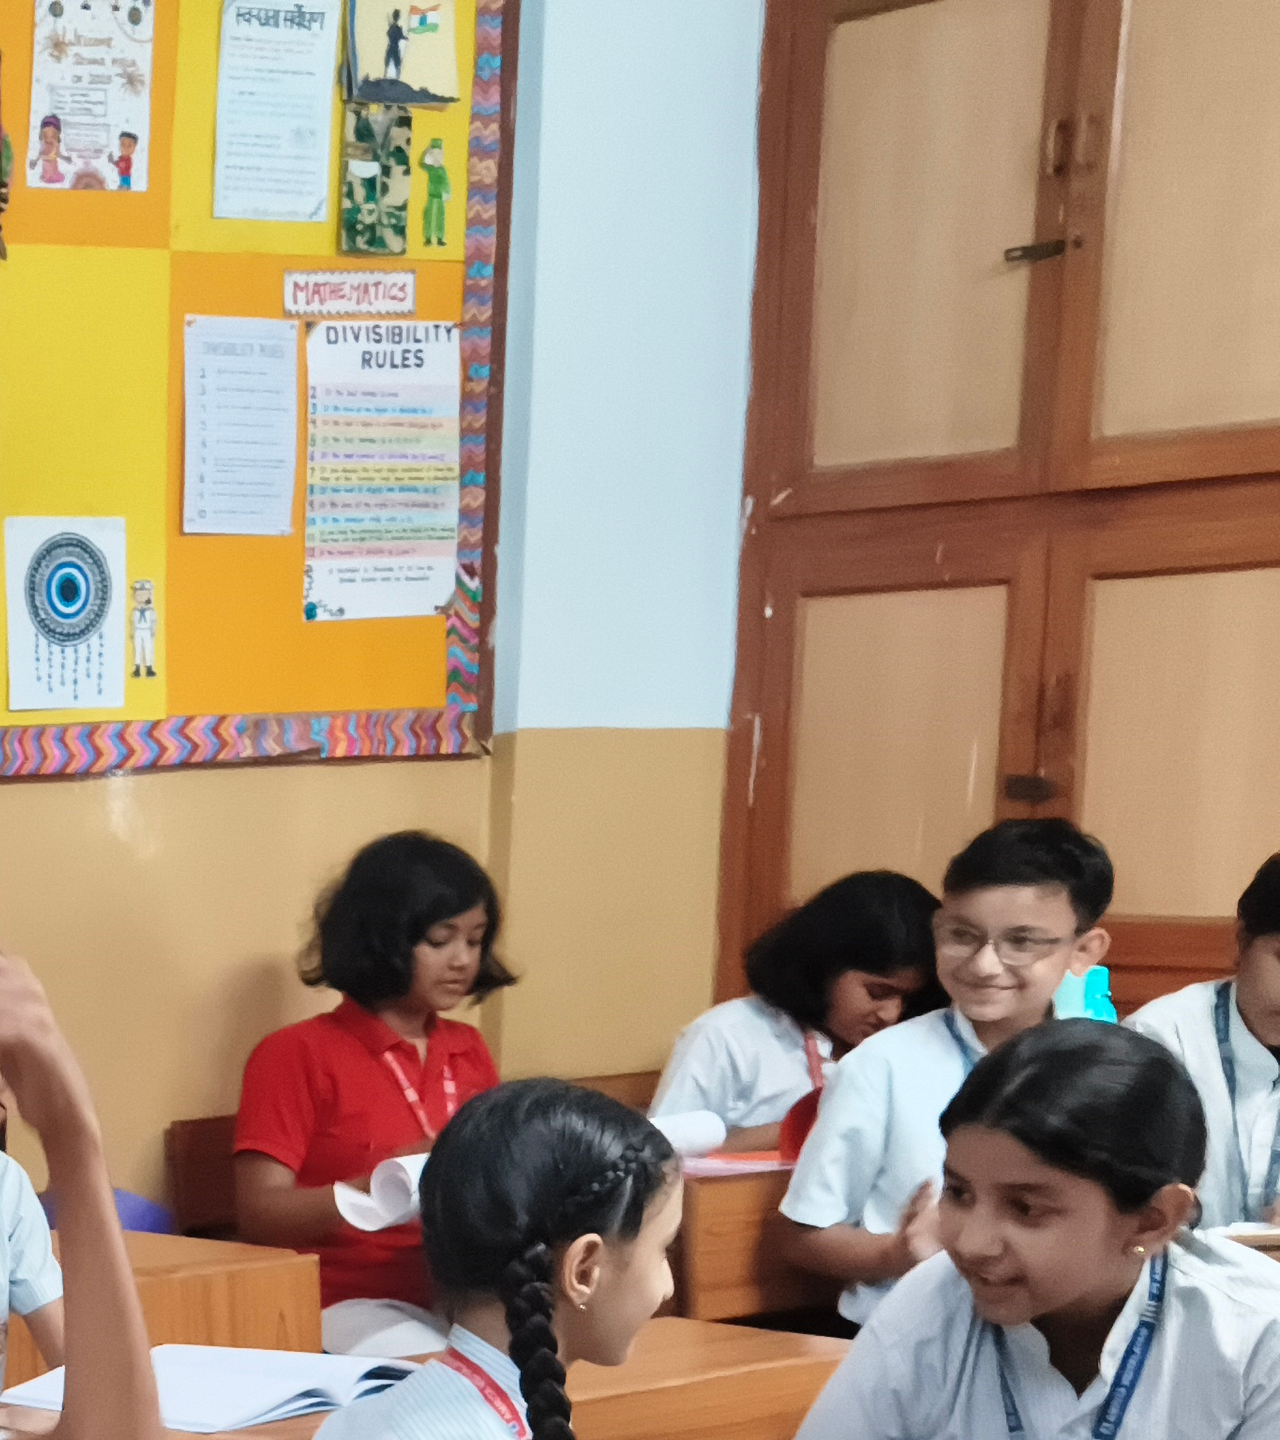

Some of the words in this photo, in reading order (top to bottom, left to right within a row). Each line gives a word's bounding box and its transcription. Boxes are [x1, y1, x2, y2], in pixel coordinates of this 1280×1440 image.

[292, 280, 408, 306] MATHEMATICS
[326, 323, 457, 346] DIVISIBILITY
[361, 349, 424, 370] RULES
